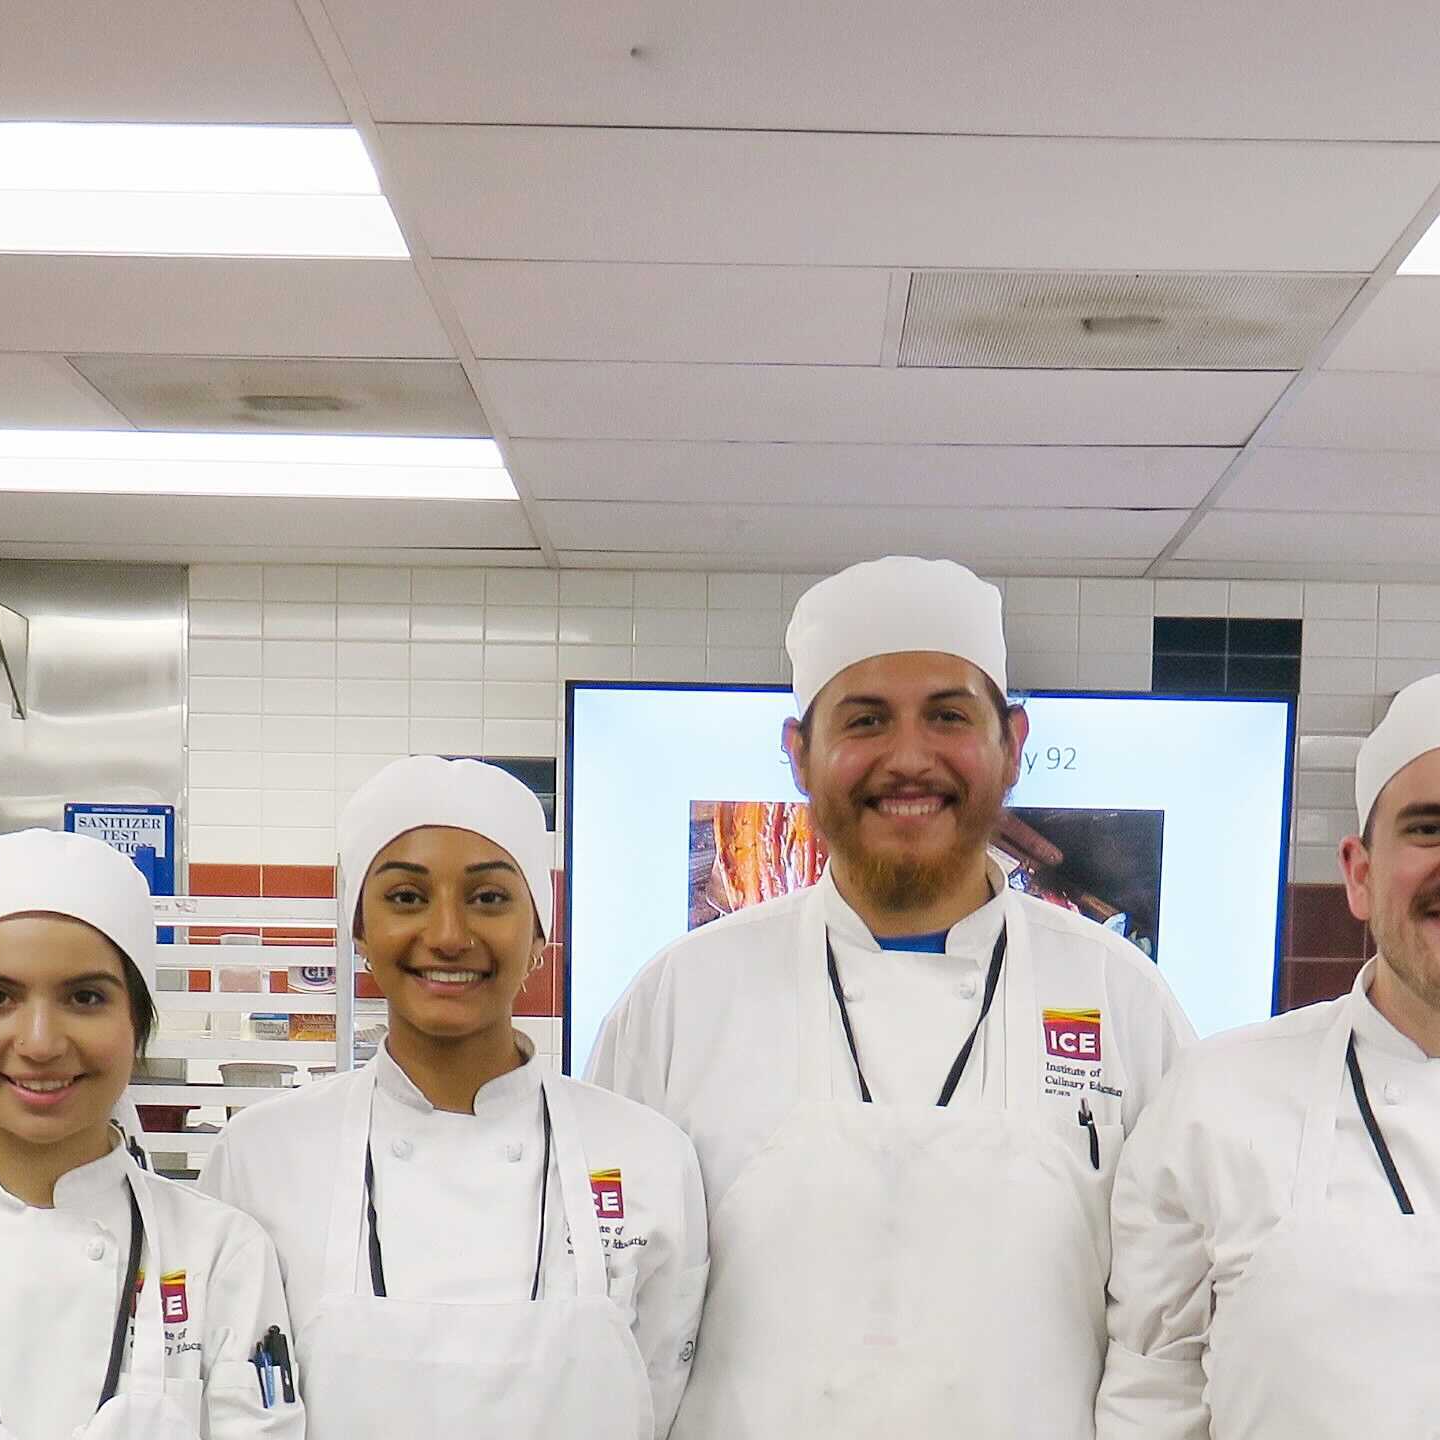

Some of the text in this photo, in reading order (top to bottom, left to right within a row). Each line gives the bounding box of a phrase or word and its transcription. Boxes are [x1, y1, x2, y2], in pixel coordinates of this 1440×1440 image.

[1047, 747, 1077, 770] 92
[78, 816, 161, 829] SANITIZER
[101, 830, 140, 841] TEST
[1050, 1030, 1096, 1054] ICE
[1046, 1062, 1102, 1077] Institute of
[1045, 1075, 1084, 1091] Culinary
